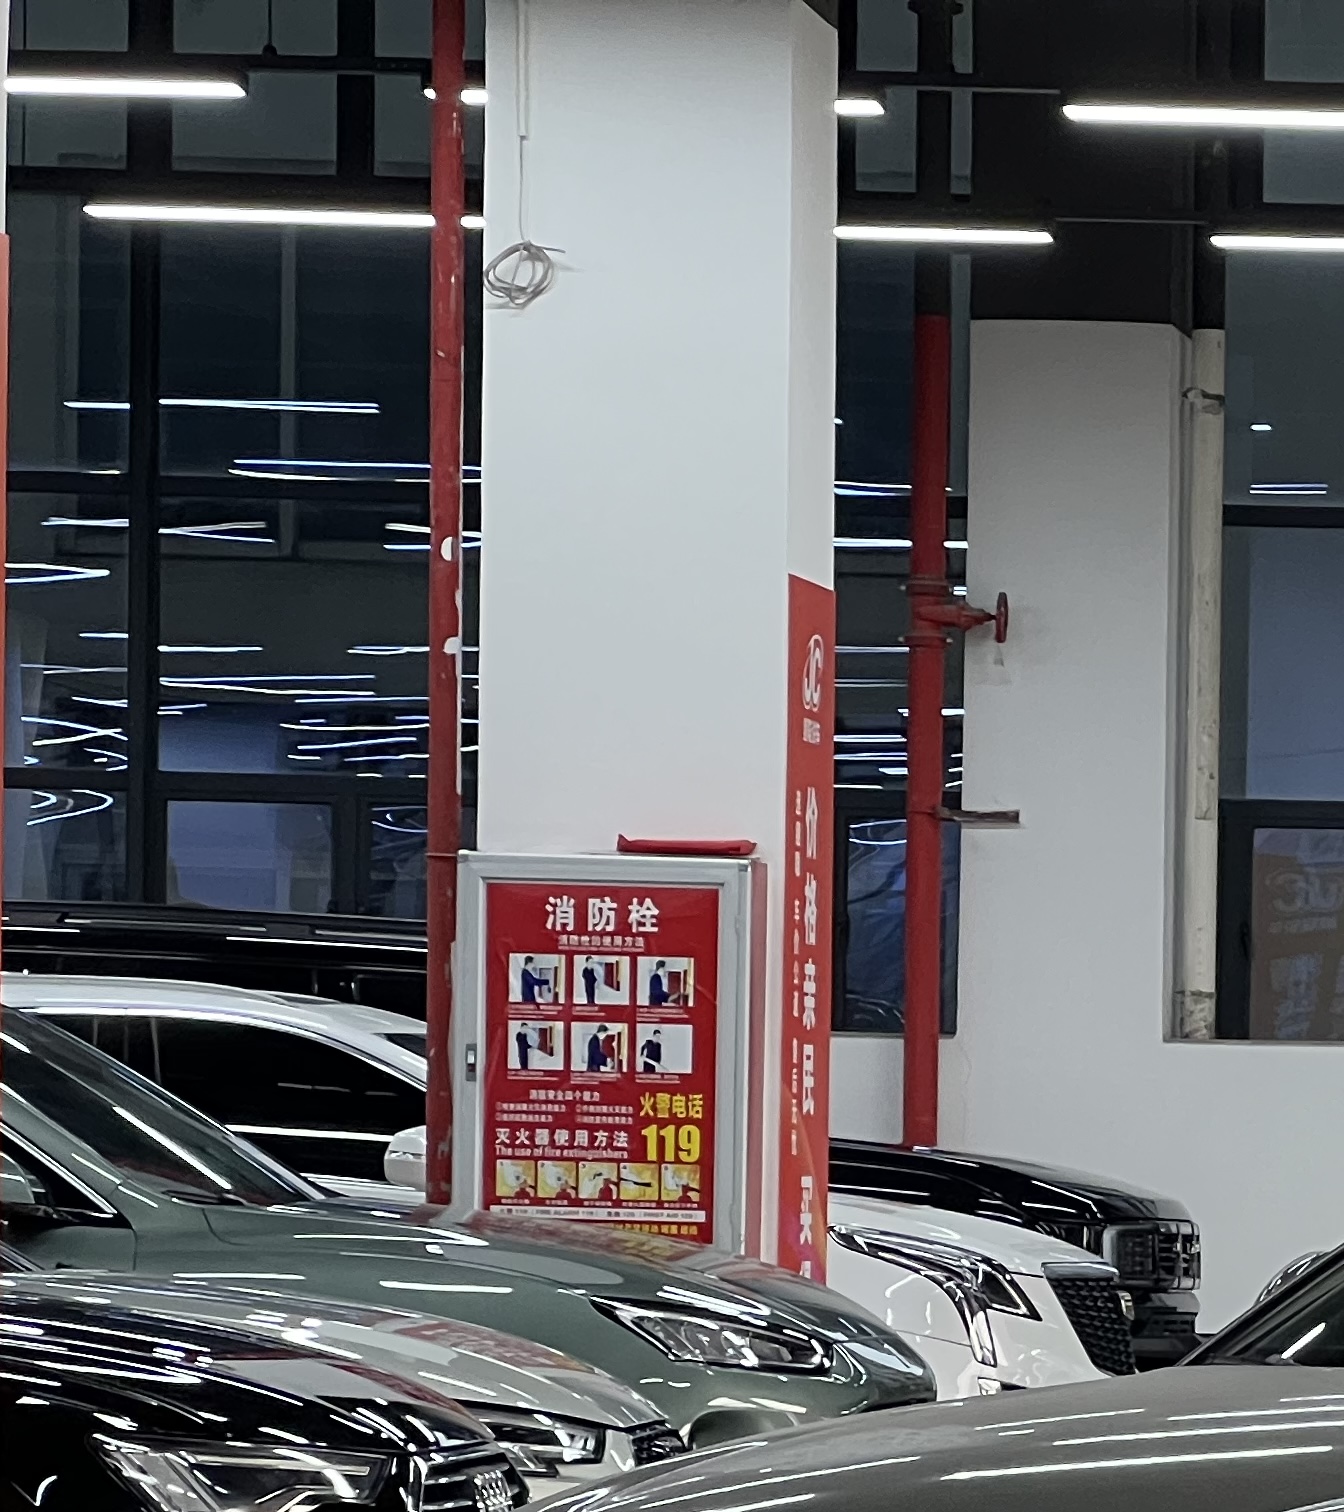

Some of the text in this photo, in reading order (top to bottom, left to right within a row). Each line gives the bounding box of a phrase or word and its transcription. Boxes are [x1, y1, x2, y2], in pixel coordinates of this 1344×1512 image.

[545, 895, 661, 934] 消防栓
[802, 786, 818, 1116] 价格亲民
[639, 1092, 704, 1119] 火警电话
[495, 1127, 629, 1148] 灭火器使用方法
[495, 1145, 513, 1156] The
[533, 1146, 544, 1156] of
[641, 1124, 701, 1163] 119
